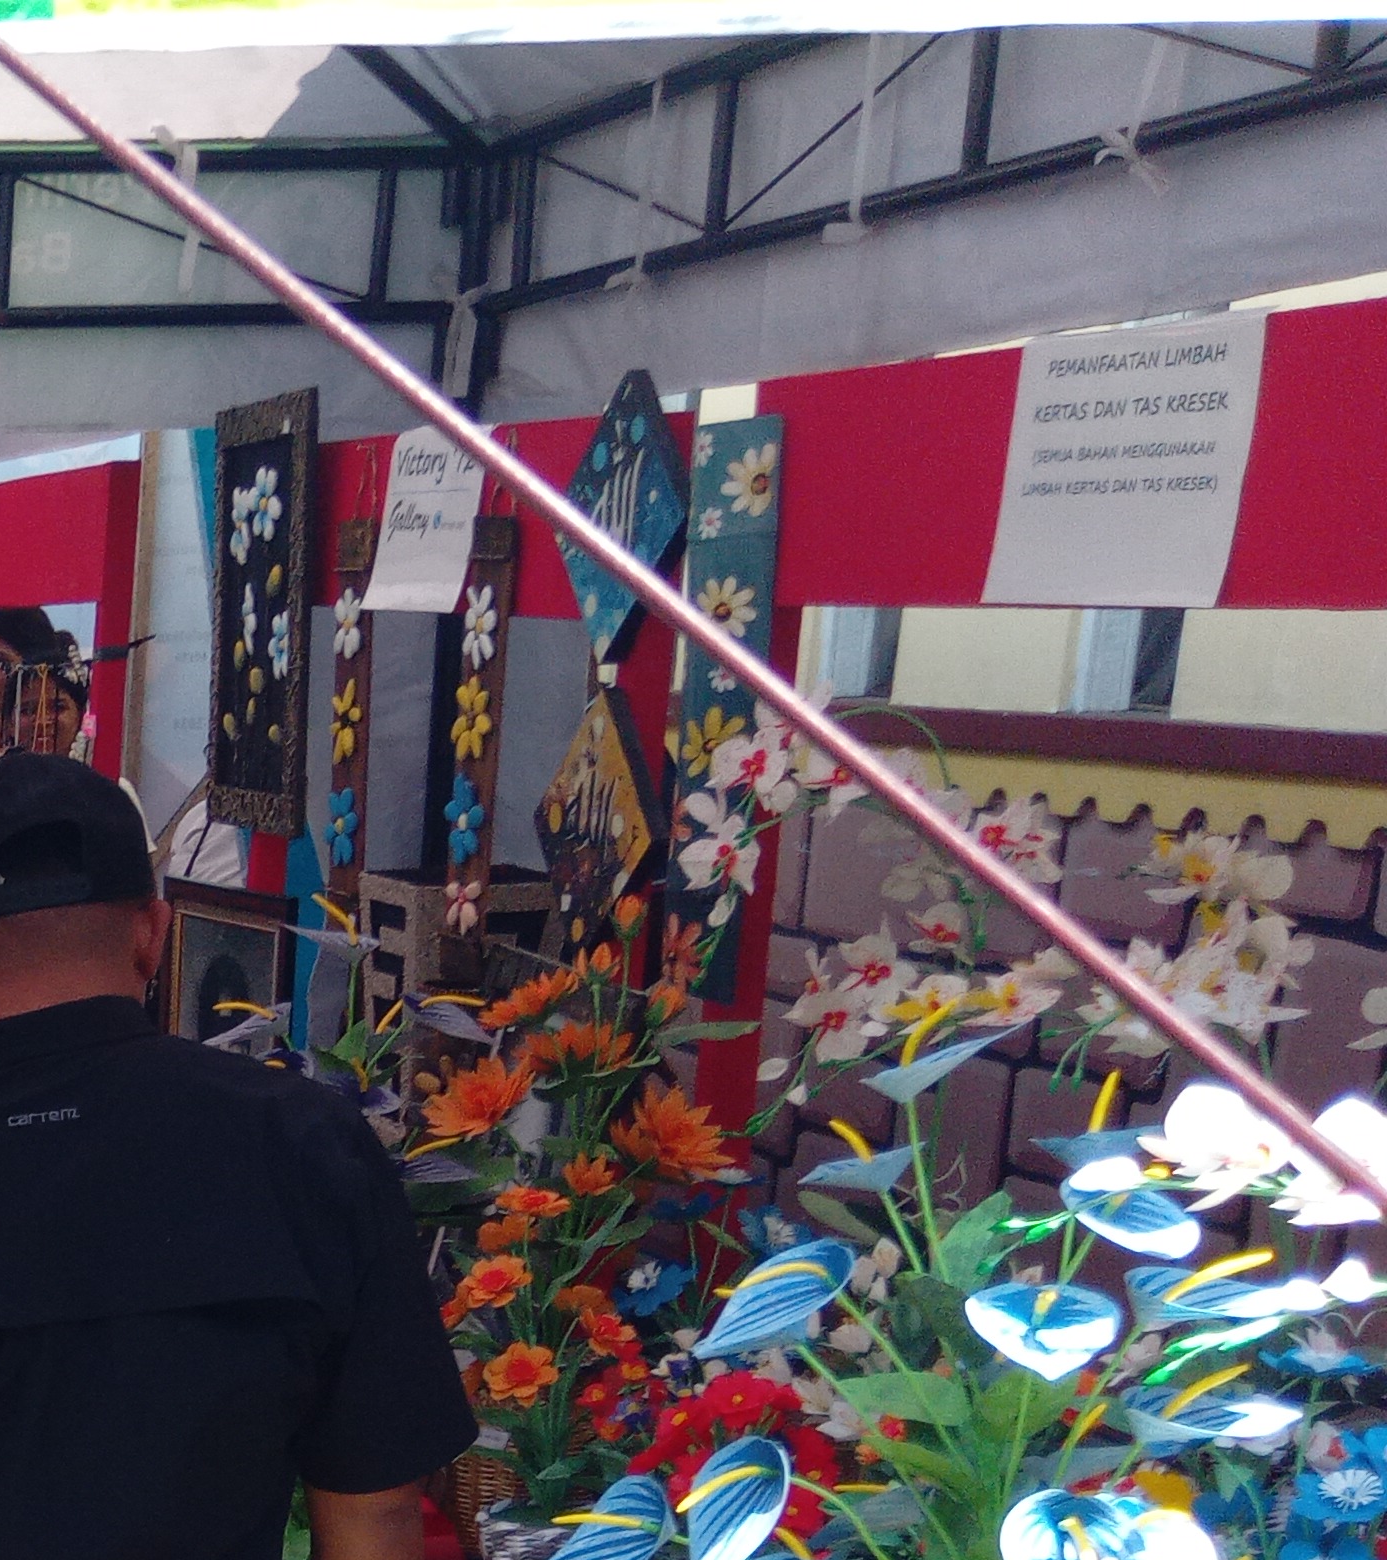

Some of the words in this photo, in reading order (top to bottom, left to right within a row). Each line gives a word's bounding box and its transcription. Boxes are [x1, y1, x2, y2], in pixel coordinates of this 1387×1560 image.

[1046, 351, 1159, 379] PEMANFAATAN
[1164, 342, 1228, 367] LIMBAH
[1033, 400, 1090, 424] KERTAS
[1093, 401, 1127, 420] DAN
[1132, 395, 1162, 416] TAS
[1165, 390, 1229, 412] KRESEK
